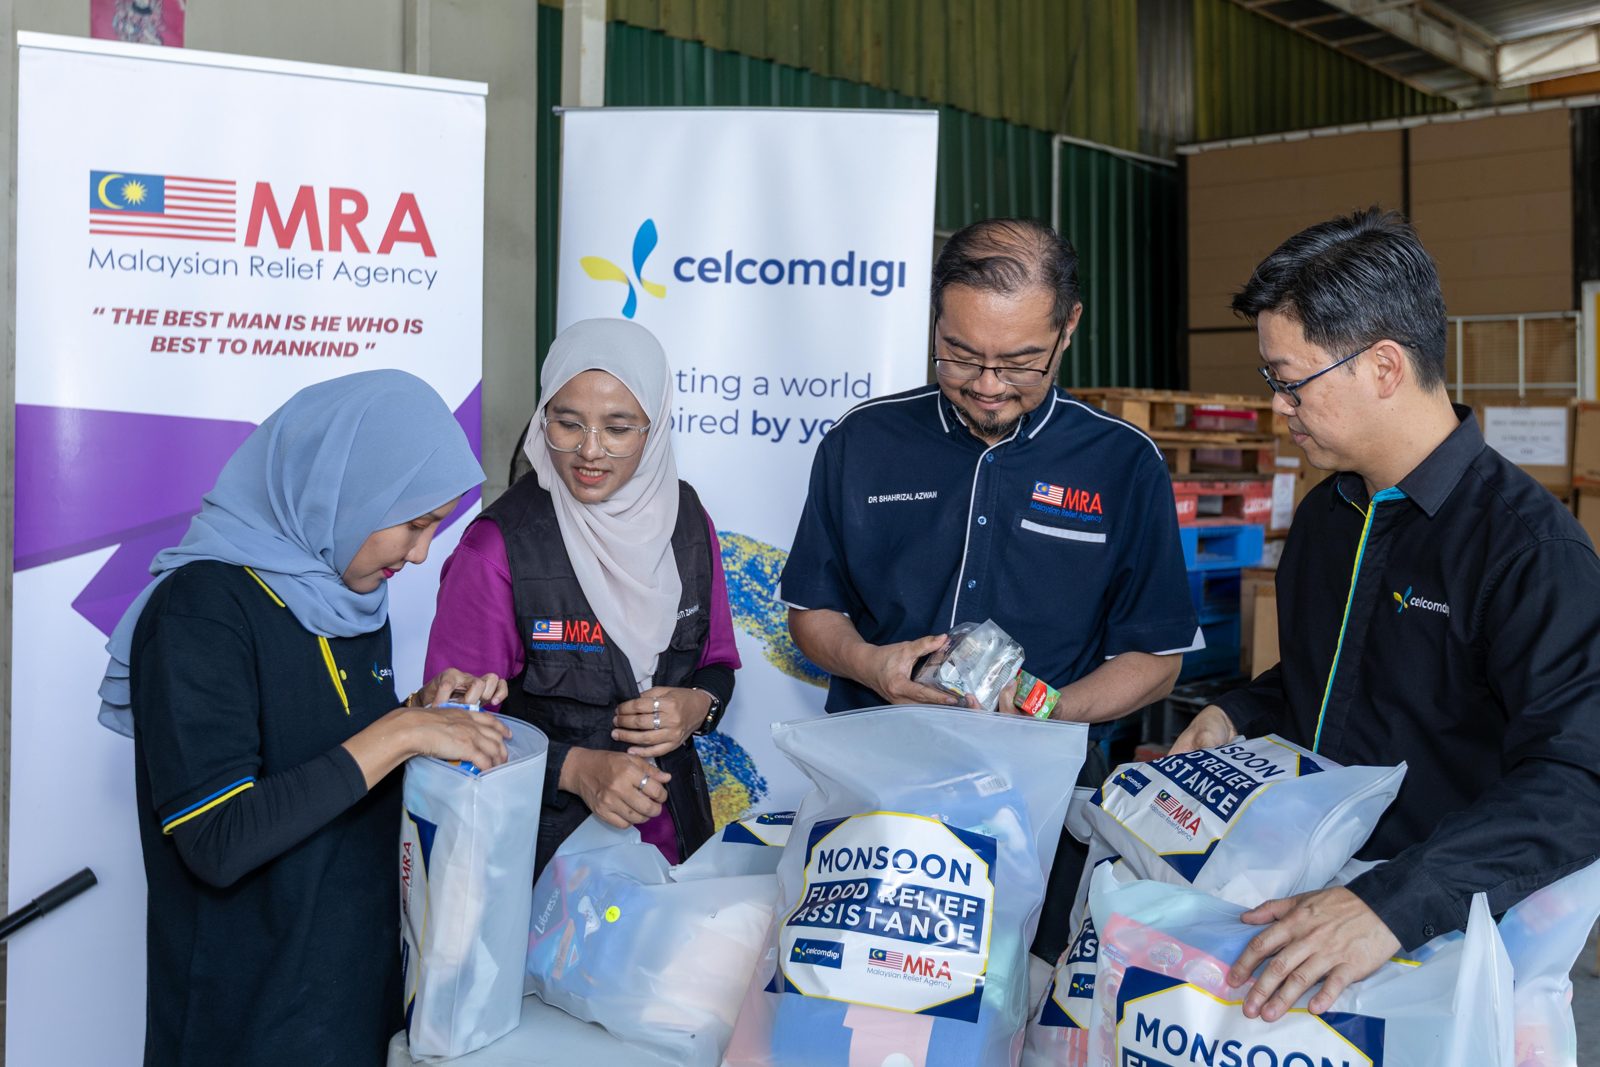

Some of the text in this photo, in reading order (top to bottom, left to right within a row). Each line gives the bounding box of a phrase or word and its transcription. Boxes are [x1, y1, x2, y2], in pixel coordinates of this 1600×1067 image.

[243, 181, 437, 258] MRA
[88, 247, 438, 290] Malaysian Relief Agency
[673, 250, 906, 297] celcomdigi
[112, 308, 159, 326] THE
[162, 310, 224, 329] BEST
[227, 312, 281, 331] MAN
[284, 314, 306, 331] IS
[310, 315, 343, 333] HE
[345, 317, 399, 334] WHO
[402, 319, 424, 335] IS
[150, 336, 212, 354] BEST
[216, 337, 249, 355] TO
[251, 339, 359, 358] MANKIND
[675, 368, 872, 401] ting a world
[751, 409, 791, 443] by
[798, 418, 836, 444] yo
[867, 490, 938, 504] DR SHAHRIZAL AZWAN
[1062, 487, 1103, 514] MRA
[563, 620, 604, 645] MRA
[1198, 758, 1256, 791] RELIEF
[1168, 804, 1201, 836] MRA
[818, 846, 972, 887] MONSOON
[806, 882, 978, 919] FLOOD RELIEF
[792, 902, 976, 948] ASSISTANCE
[866, 967, 952, 989] Malaysian Relief Agency
[902, 954, 953, 981] MRA
